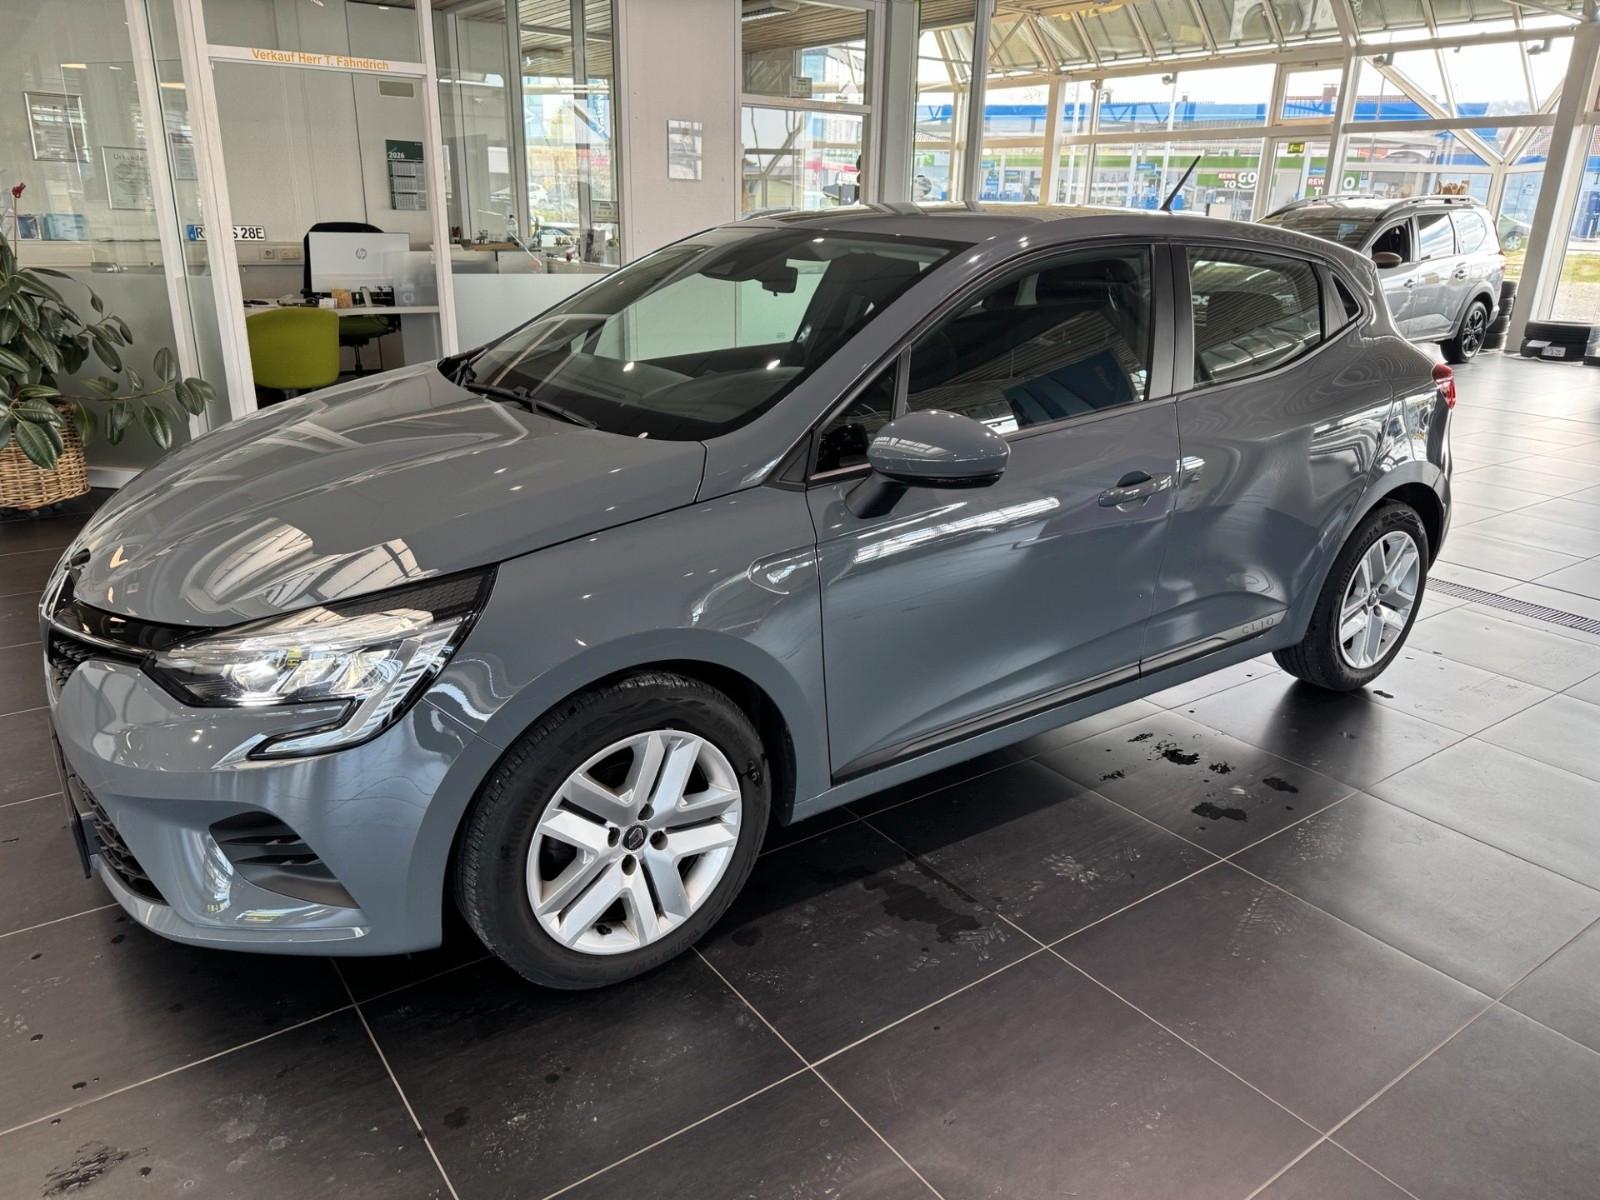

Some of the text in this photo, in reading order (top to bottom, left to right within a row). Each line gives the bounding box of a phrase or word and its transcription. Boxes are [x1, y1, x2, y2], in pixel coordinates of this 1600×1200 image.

[251, 48, 296, 62] Verkauf
[298, 52, 322, 65] Herr
[323, 56, 334, 66] T.
[1224, 180, 1236, 188] TO
[1238, 172, 1257, 183] GO
[241, 227, 264, 239] 28E
